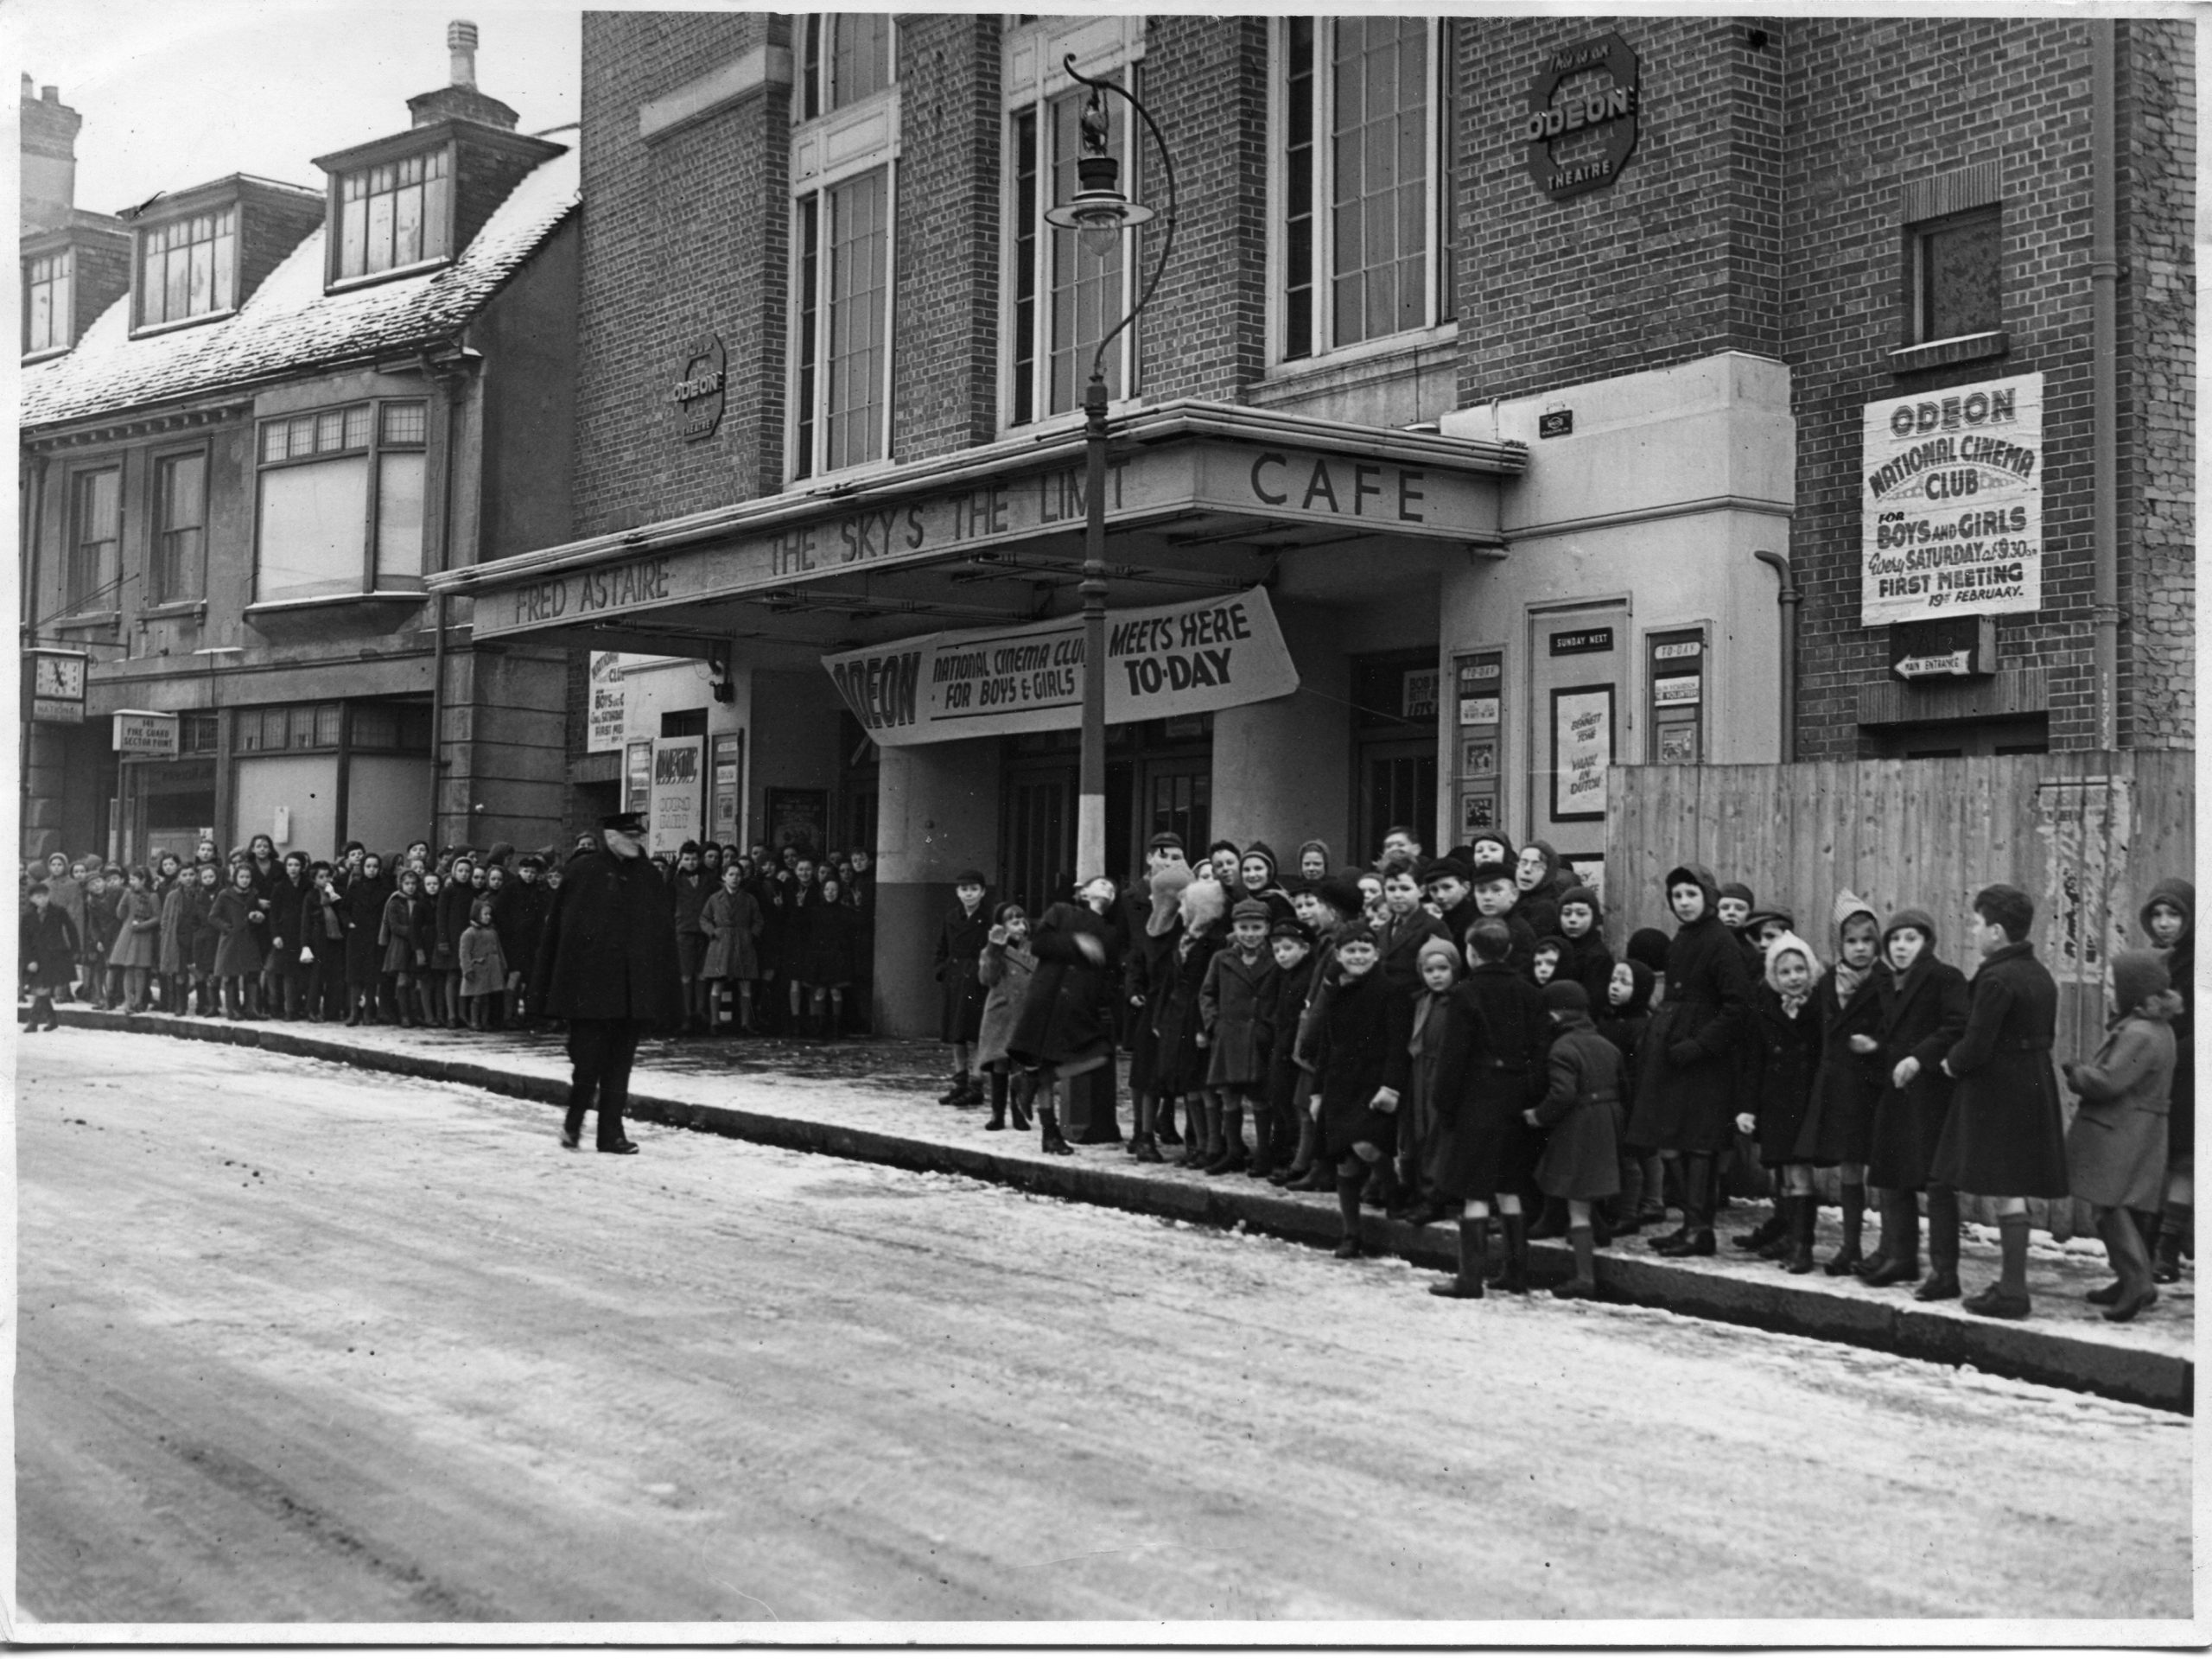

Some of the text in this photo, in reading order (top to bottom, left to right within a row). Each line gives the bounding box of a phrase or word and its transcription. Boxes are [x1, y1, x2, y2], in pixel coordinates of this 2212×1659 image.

[1527, 86, 1628, 141] ODEON
[1548, 160, 1611, 190] THEATRE
[674, 372, 719, 402] ODEON
[1890, 388, 2017, 438] ODEON
[1868, 435, 2035, 499] NATIONAL CINEMA
[1250, 452, 1426, 523] CAFE
[1924, 468, 1979, 500] CLUB
[772, 525, 816, 575] THE
[948, 482, 1008, 540] THE
[1040, 458, 1131, 524] LIMT
[1877, 506, 2027, 550] BOYS AND GIRLS
[1878, 512, 1905, 524] FOR
[1868, 552, 1905, 576] Every
[1905, 541, 1984, 571] SATURDAY
[516, 557, 670, 624] FRED ASTAIRE
[1879, 563, 2024, 598] FIRST MEETING
[1109, 603, 1251, 658] MEETS HERE
[1557, 633, 1608, 648] SUNDAY NEXT
[933, 638, 1084, 683] NATIONAL CINEMA CLU
[1661, 644, 1695, 658] TO-DAY
[1904, 657, 1960, 671] MAIN ENTRANCE
[594, 693, 613, 709] BOYS
[945, 682, 972, 709] FOR
[980, 677, 1017, 706] BOYS
[1033, 668, 1076, 700] GIRLS
[127, 728, 170, 738] FIRE GUARD
[1571, 712, 1602, 731] BENNETT
[124, 736, 173, 748] SECTOR POINT
[1570, 776, 1601, 795] DUTCH
